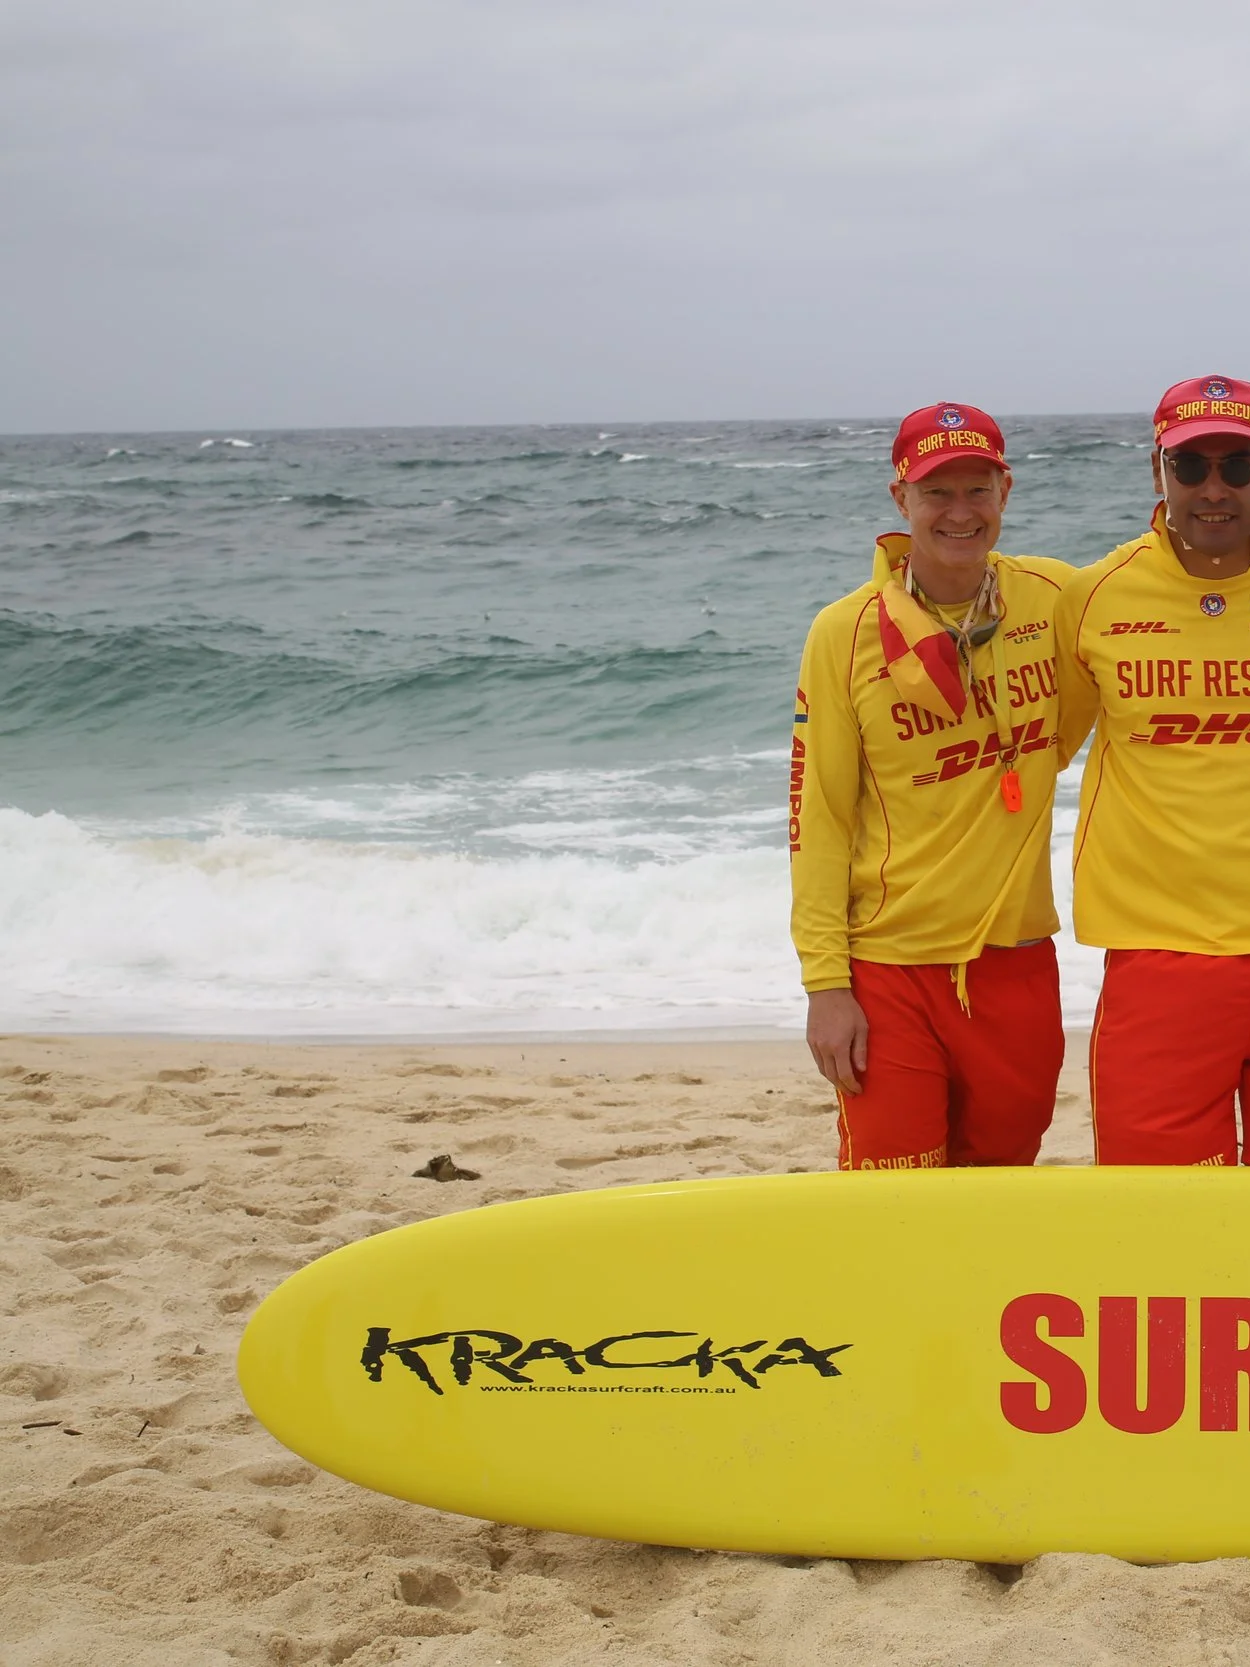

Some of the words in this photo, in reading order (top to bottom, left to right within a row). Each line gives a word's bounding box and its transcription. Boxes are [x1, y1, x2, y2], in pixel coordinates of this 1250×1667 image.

[1176, 401, 1208, 421] SURF
[916, 431, 946, 457] SURF
[948, 430, 991, 452] RESCUE
[1003, 620, 1049, 640] SUZU
[1013, 632, 1041, 645] UTE
[1109, 621, 1172, 635] DHL
[1117, 659, 1193, 699] SURF
[890, 701, 963, 741] SU
[970, 656, 1058, 719] RSCU
[935, 717, 1050, 782] DHL
[788, 735, 806, 863] AMPOL
[360, 1327, 855, 1395] KRACKA
[480, 1384, 736, 1394] www.krackasurfcraft.com.au
